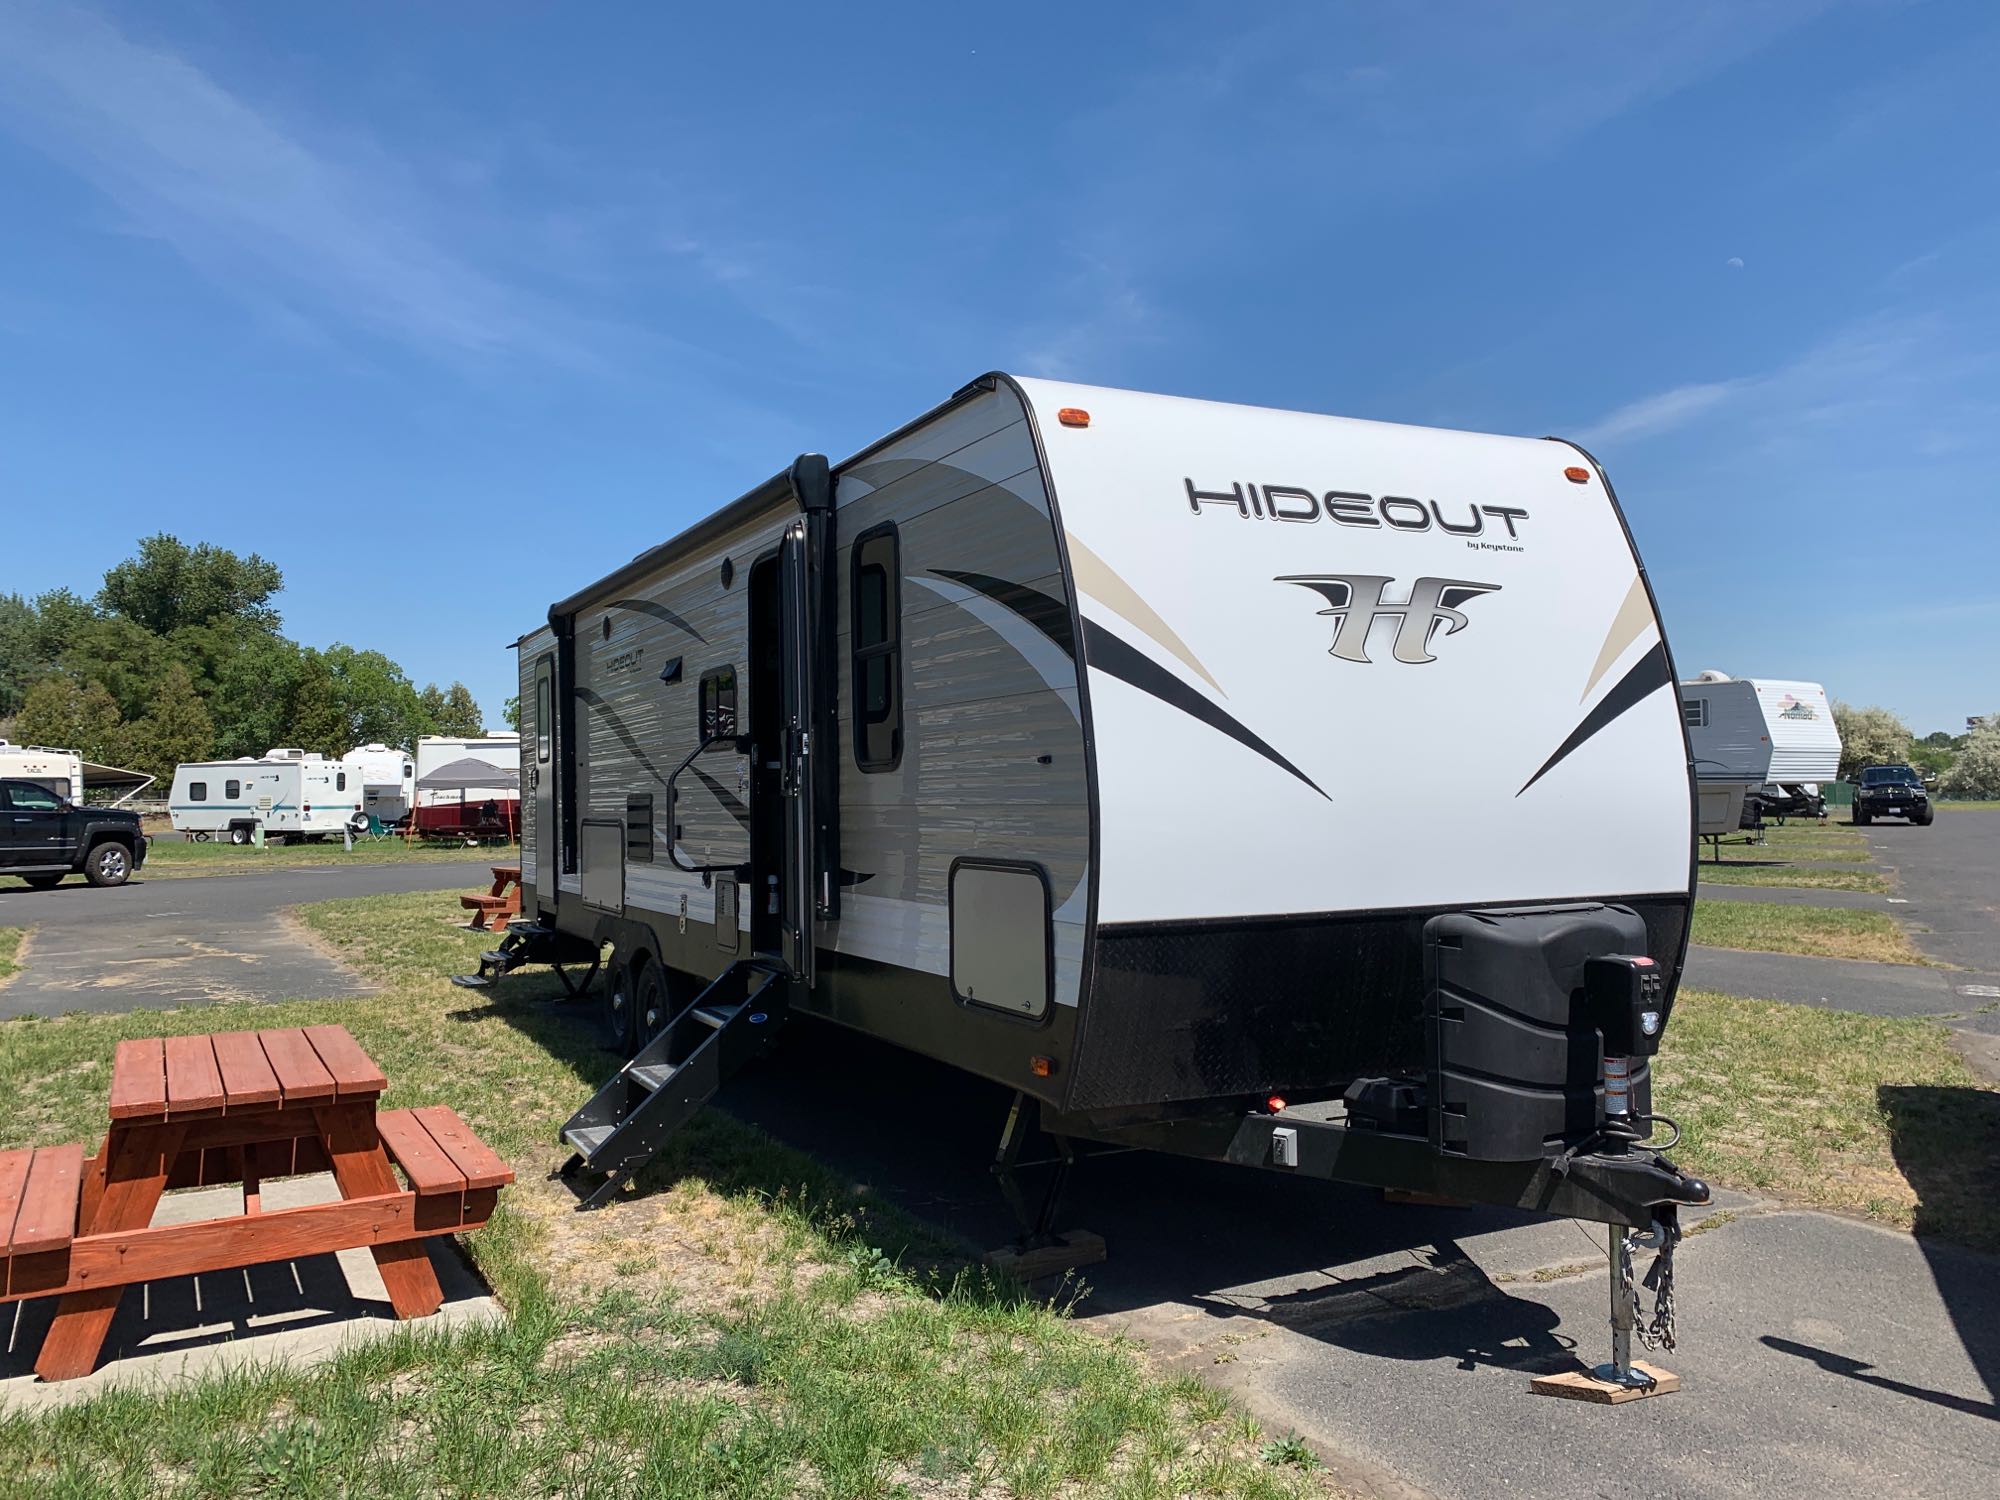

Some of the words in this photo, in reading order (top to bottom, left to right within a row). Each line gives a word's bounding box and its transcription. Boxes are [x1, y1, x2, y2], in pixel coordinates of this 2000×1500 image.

[1184, 476, 1530, 541] HIDEOUT
[1467, 541, 1480, 550] by
[1481, 542, 1524, 552] Keystone
[606, 648, 644, 674] HIDEOUT
